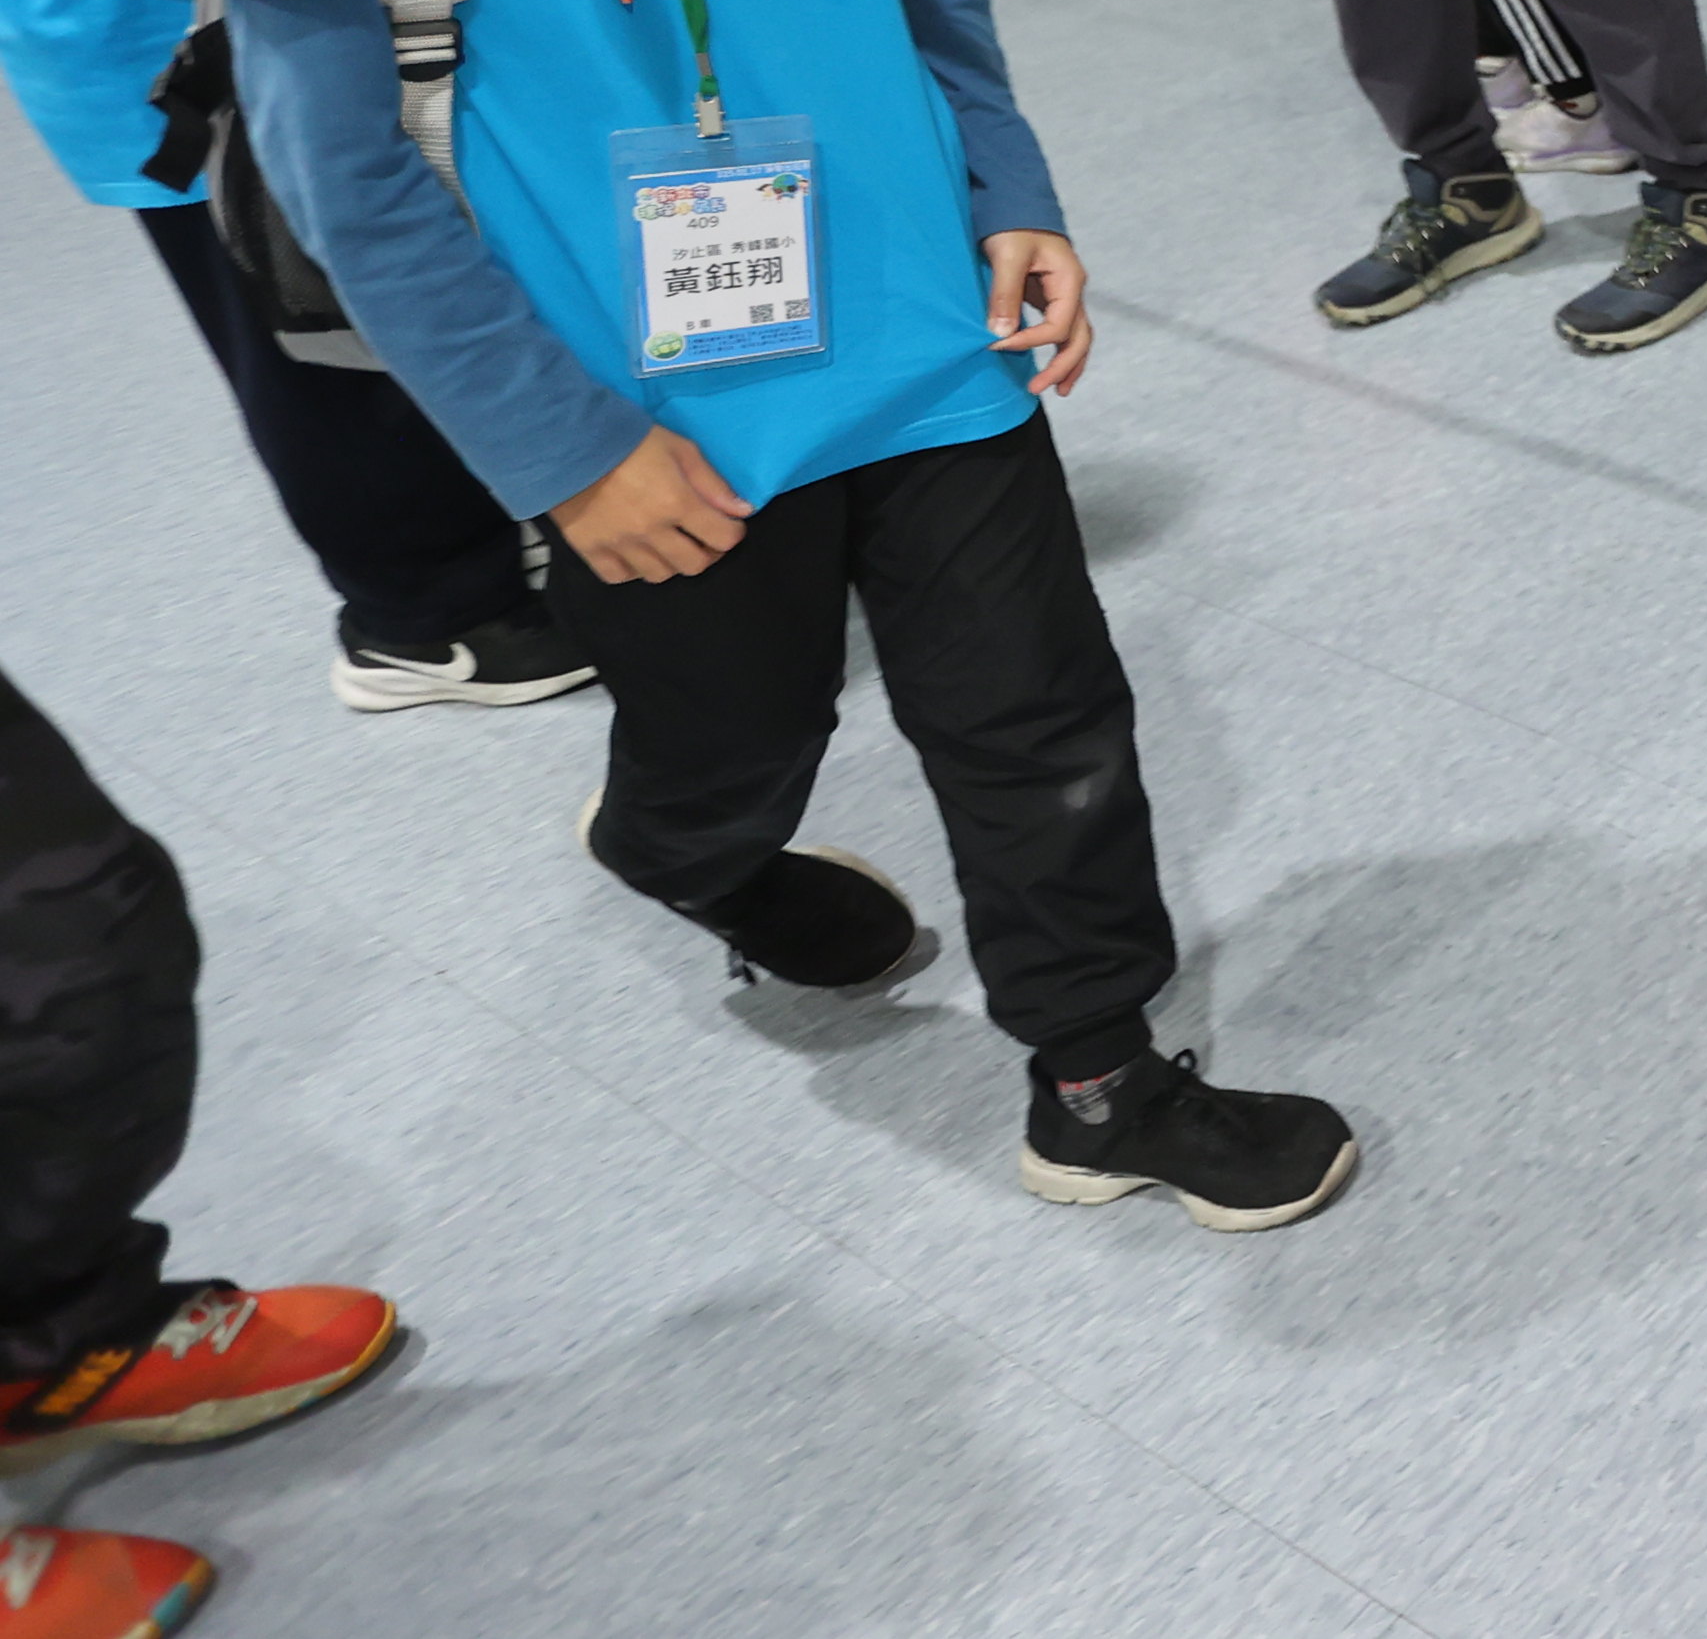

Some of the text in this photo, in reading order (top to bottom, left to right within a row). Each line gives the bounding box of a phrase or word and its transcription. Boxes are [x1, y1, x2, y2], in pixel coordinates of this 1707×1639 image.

[686, 215, 720, 229] 409
[672, 243, 722, 262] 汐止區
[663, 255, 784, 298] 黃鈺翔
